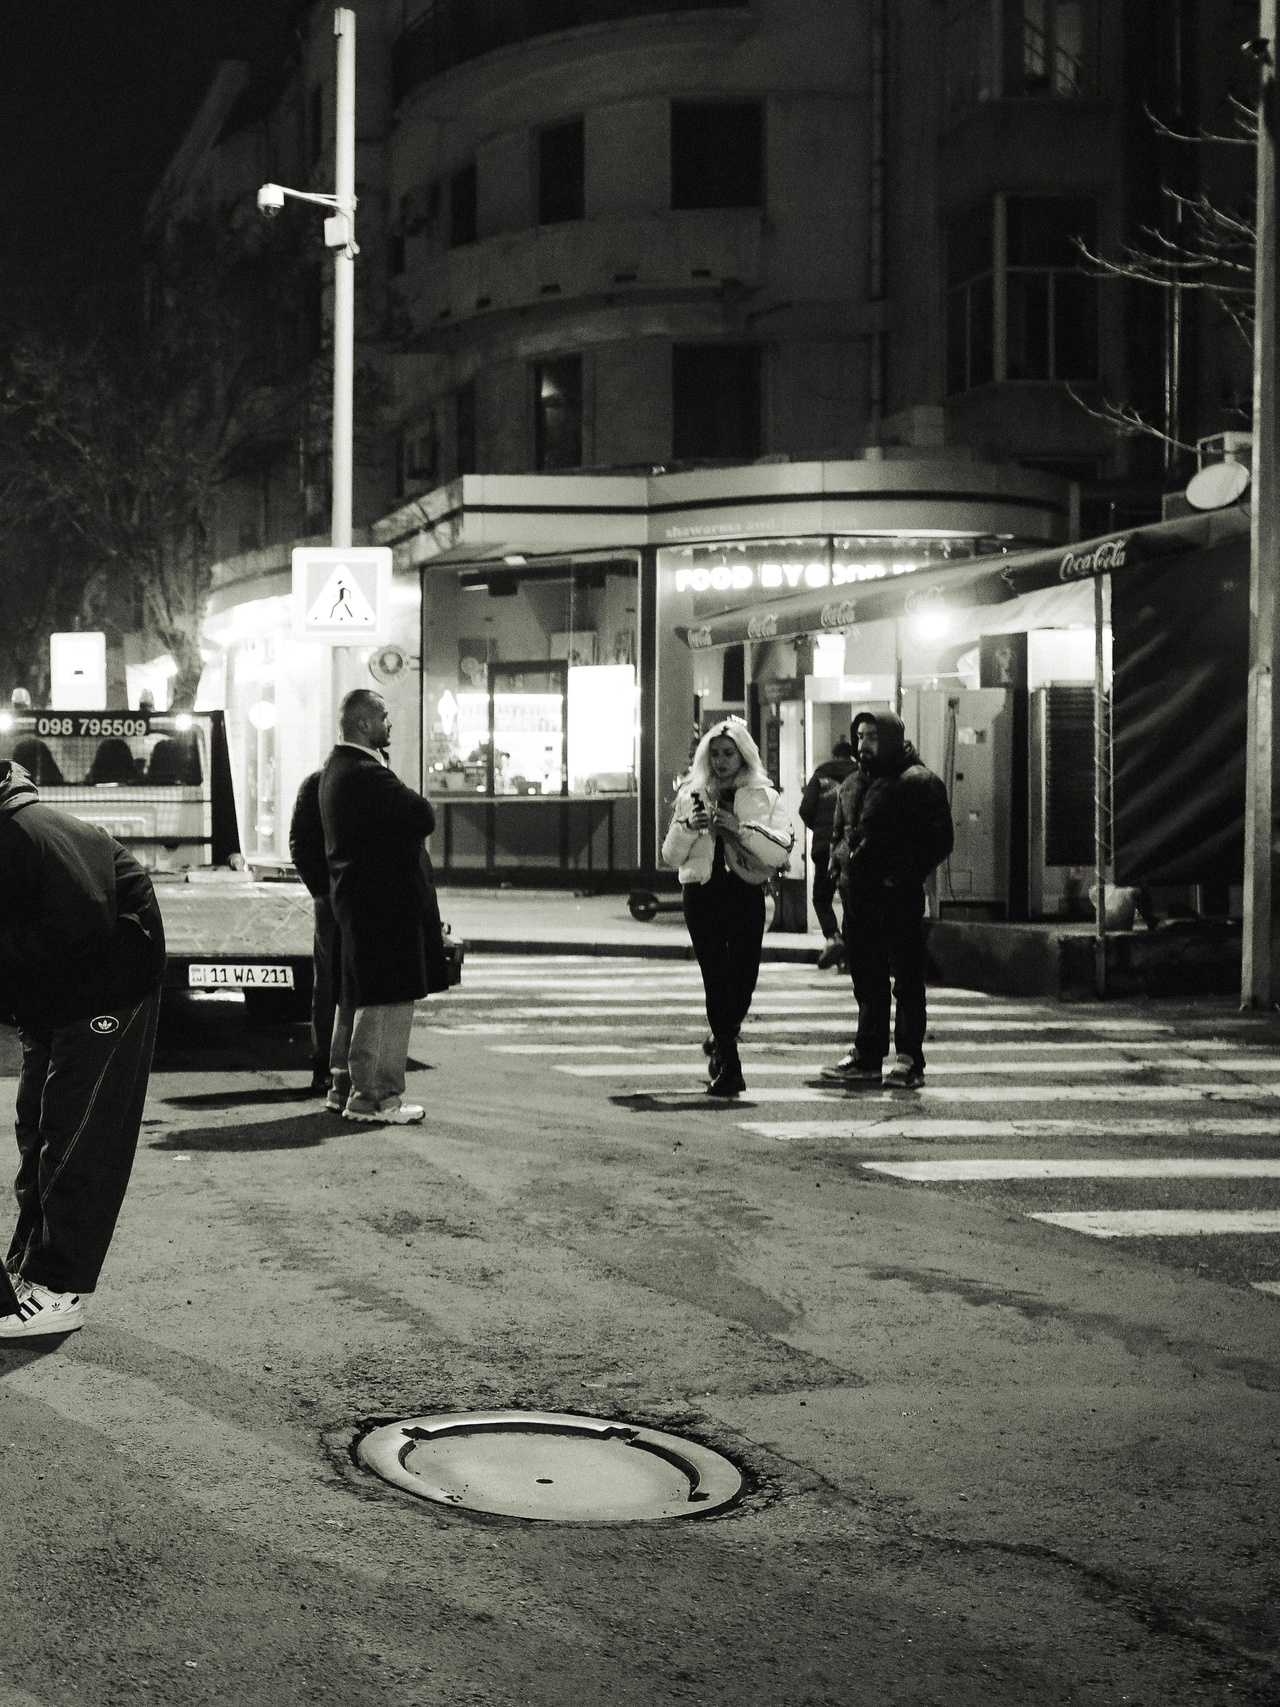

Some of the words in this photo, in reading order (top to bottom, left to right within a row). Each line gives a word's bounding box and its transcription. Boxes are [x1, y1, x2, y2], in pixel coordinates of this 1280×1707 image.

[676, 566, 753, 591] FOOD
[761, 564, 803, 587] BY
[39, 718, 73, 735] 098
[79, 719, 147, 736] 795509
[211, 968, 228, 983] 11
[234, 968, 255, 983] WA
[261, 969, 289, 984] 211
